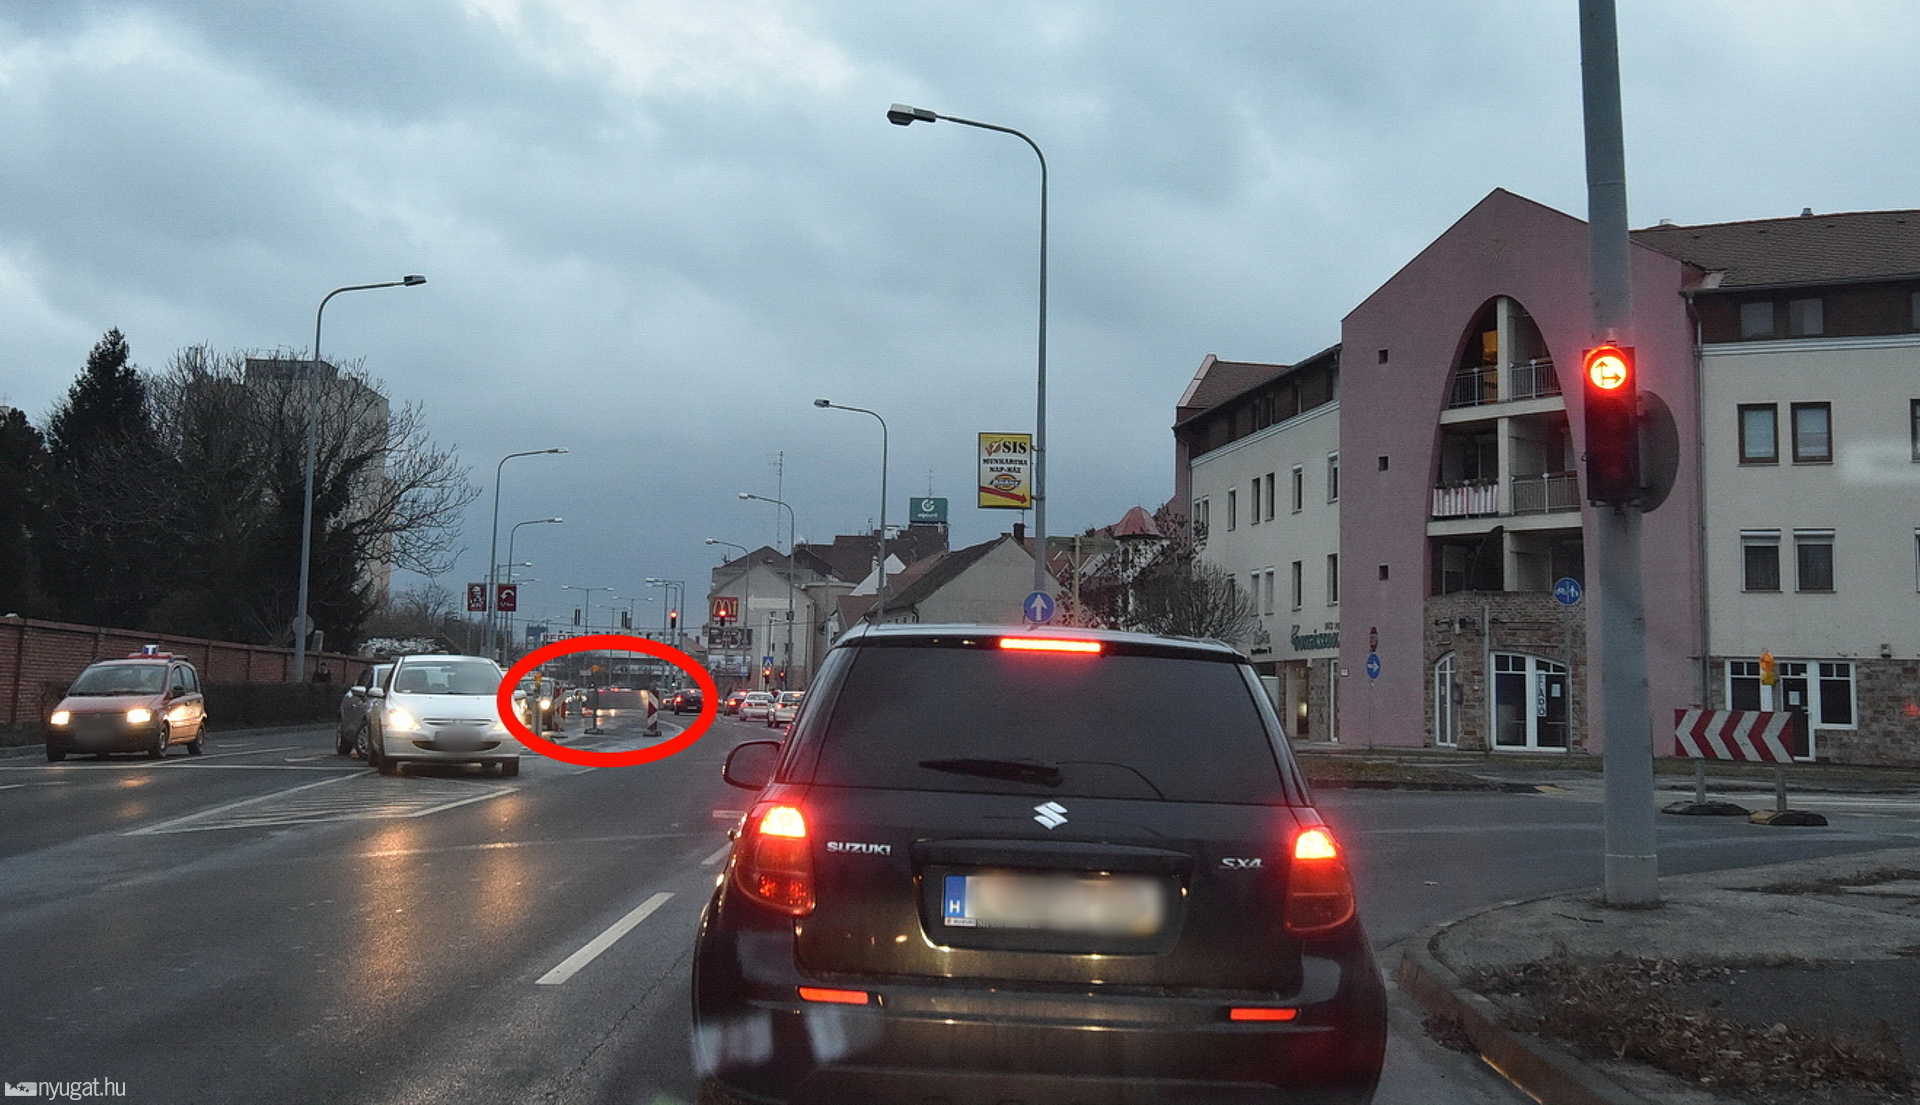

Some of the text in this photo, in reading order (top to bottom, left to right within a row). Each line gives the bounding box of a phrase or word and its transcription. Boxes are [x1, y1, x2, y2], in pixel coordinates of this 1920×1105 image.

[826, 841, 891, 855] SUZUKI
[1220, 857, 1263, 869] SX4
[949, 900, 960, 913] H
